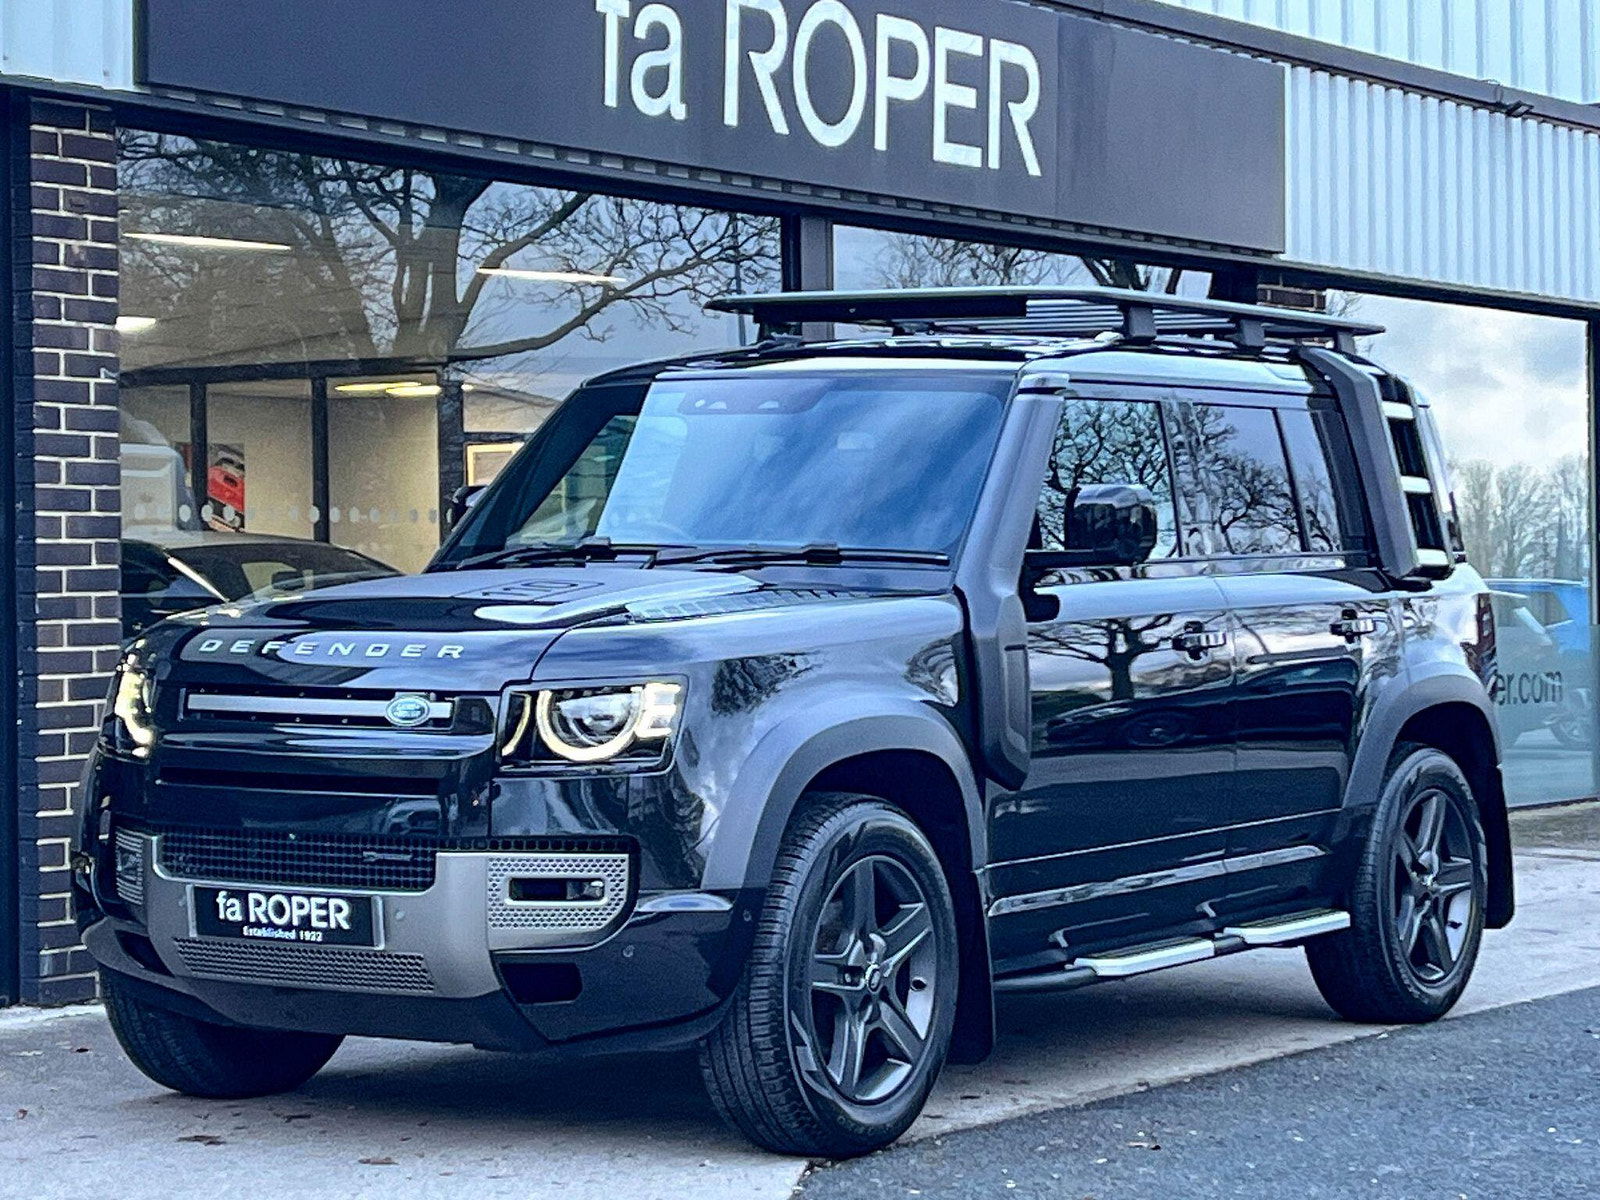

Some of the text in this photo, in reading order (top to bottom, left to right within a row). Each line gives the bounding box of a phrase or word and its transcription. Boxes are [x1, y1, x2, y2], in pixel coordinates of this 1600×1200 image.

[595, 0, 1042, 177] fa ROPER
[198, 639, 465, 660] DEFENDER
[216, 890, 351, 930] fa ROPER
